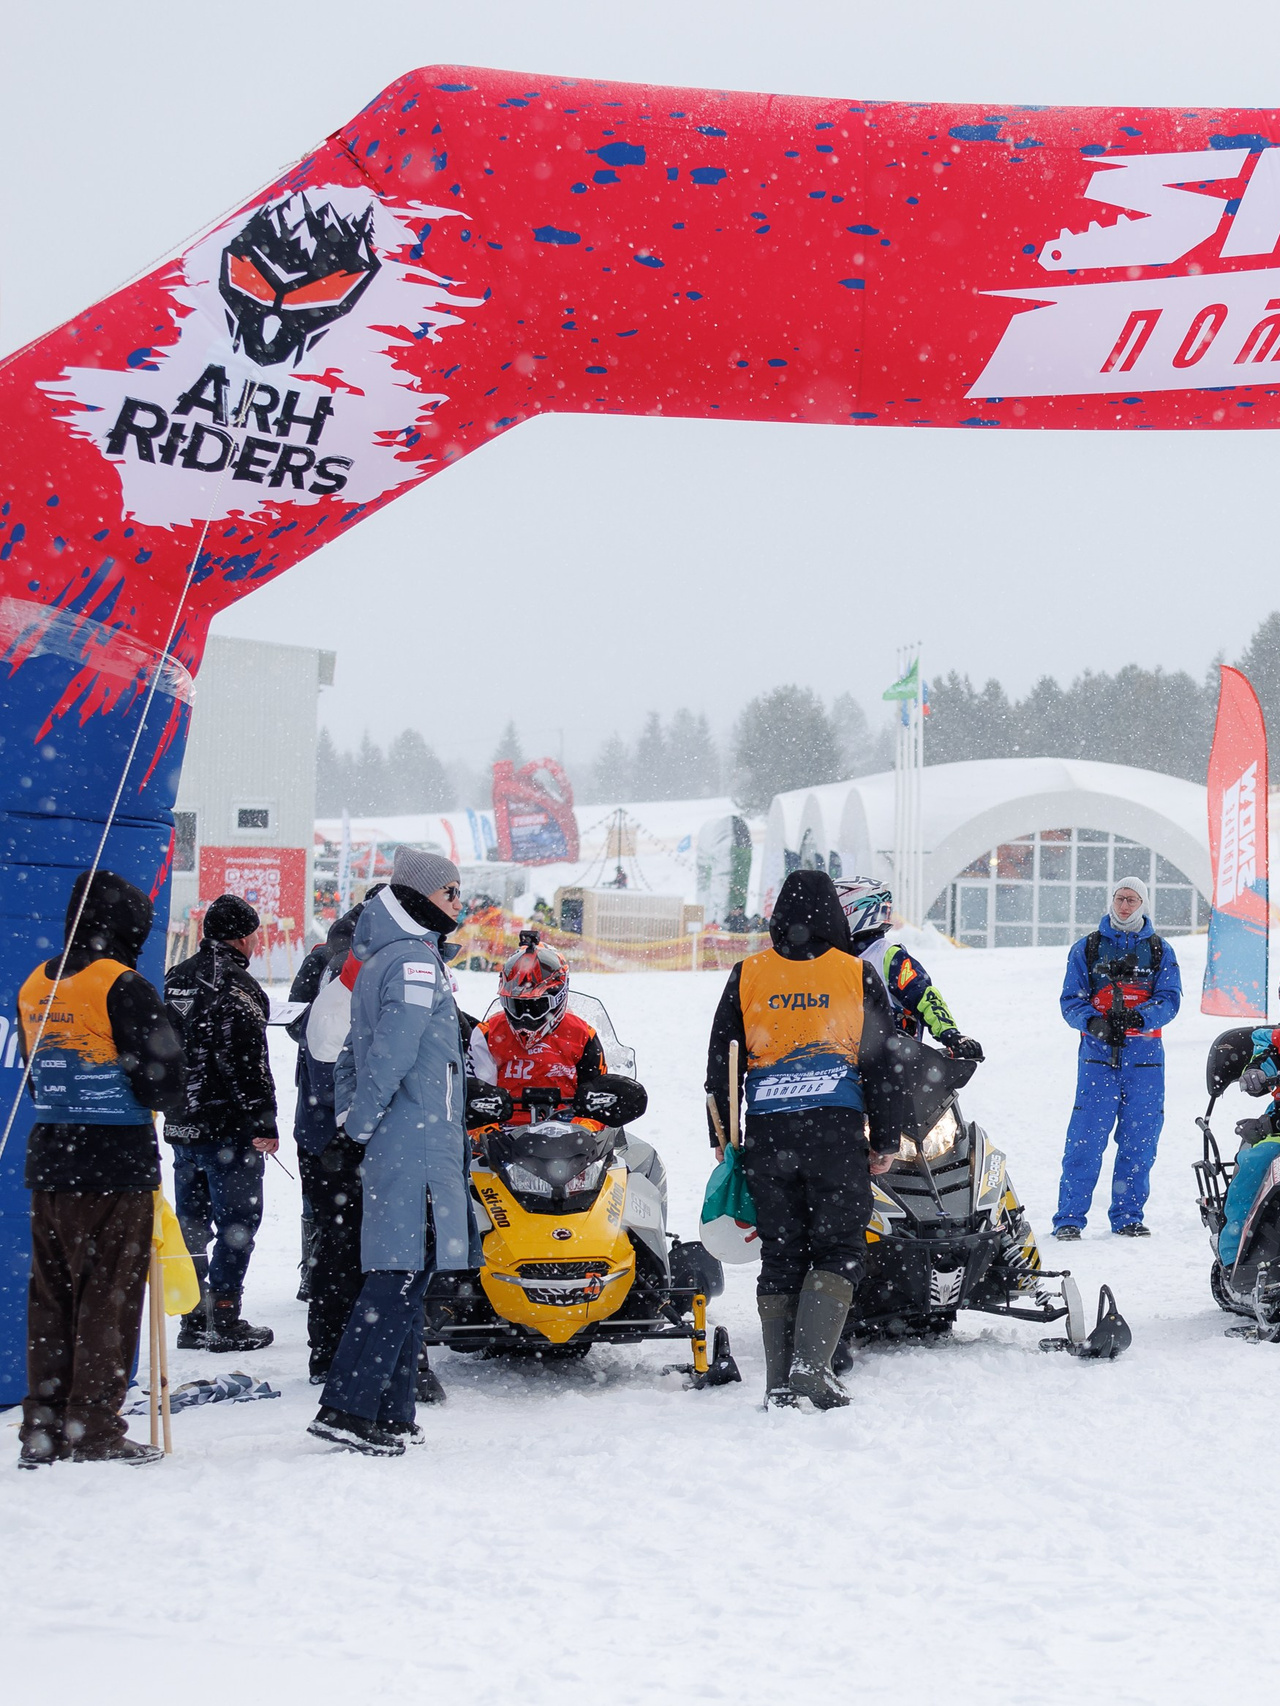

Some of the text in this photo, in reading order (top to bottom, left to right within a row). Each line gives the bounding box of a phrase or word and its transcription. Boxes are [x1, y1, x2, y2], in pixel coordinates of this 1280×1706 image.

[172, 363, 335, 446] ARH
[102, 396, 357, 496] RIDERS
[768, 992, 830, 1011] СУДЬЯ
[29, 1013, 74, 1024] МАРШАЛ
[765, 1082, 824, 1097] ПОМОРЬЕ
[481, 1187, 511, 1228] ski-doo
